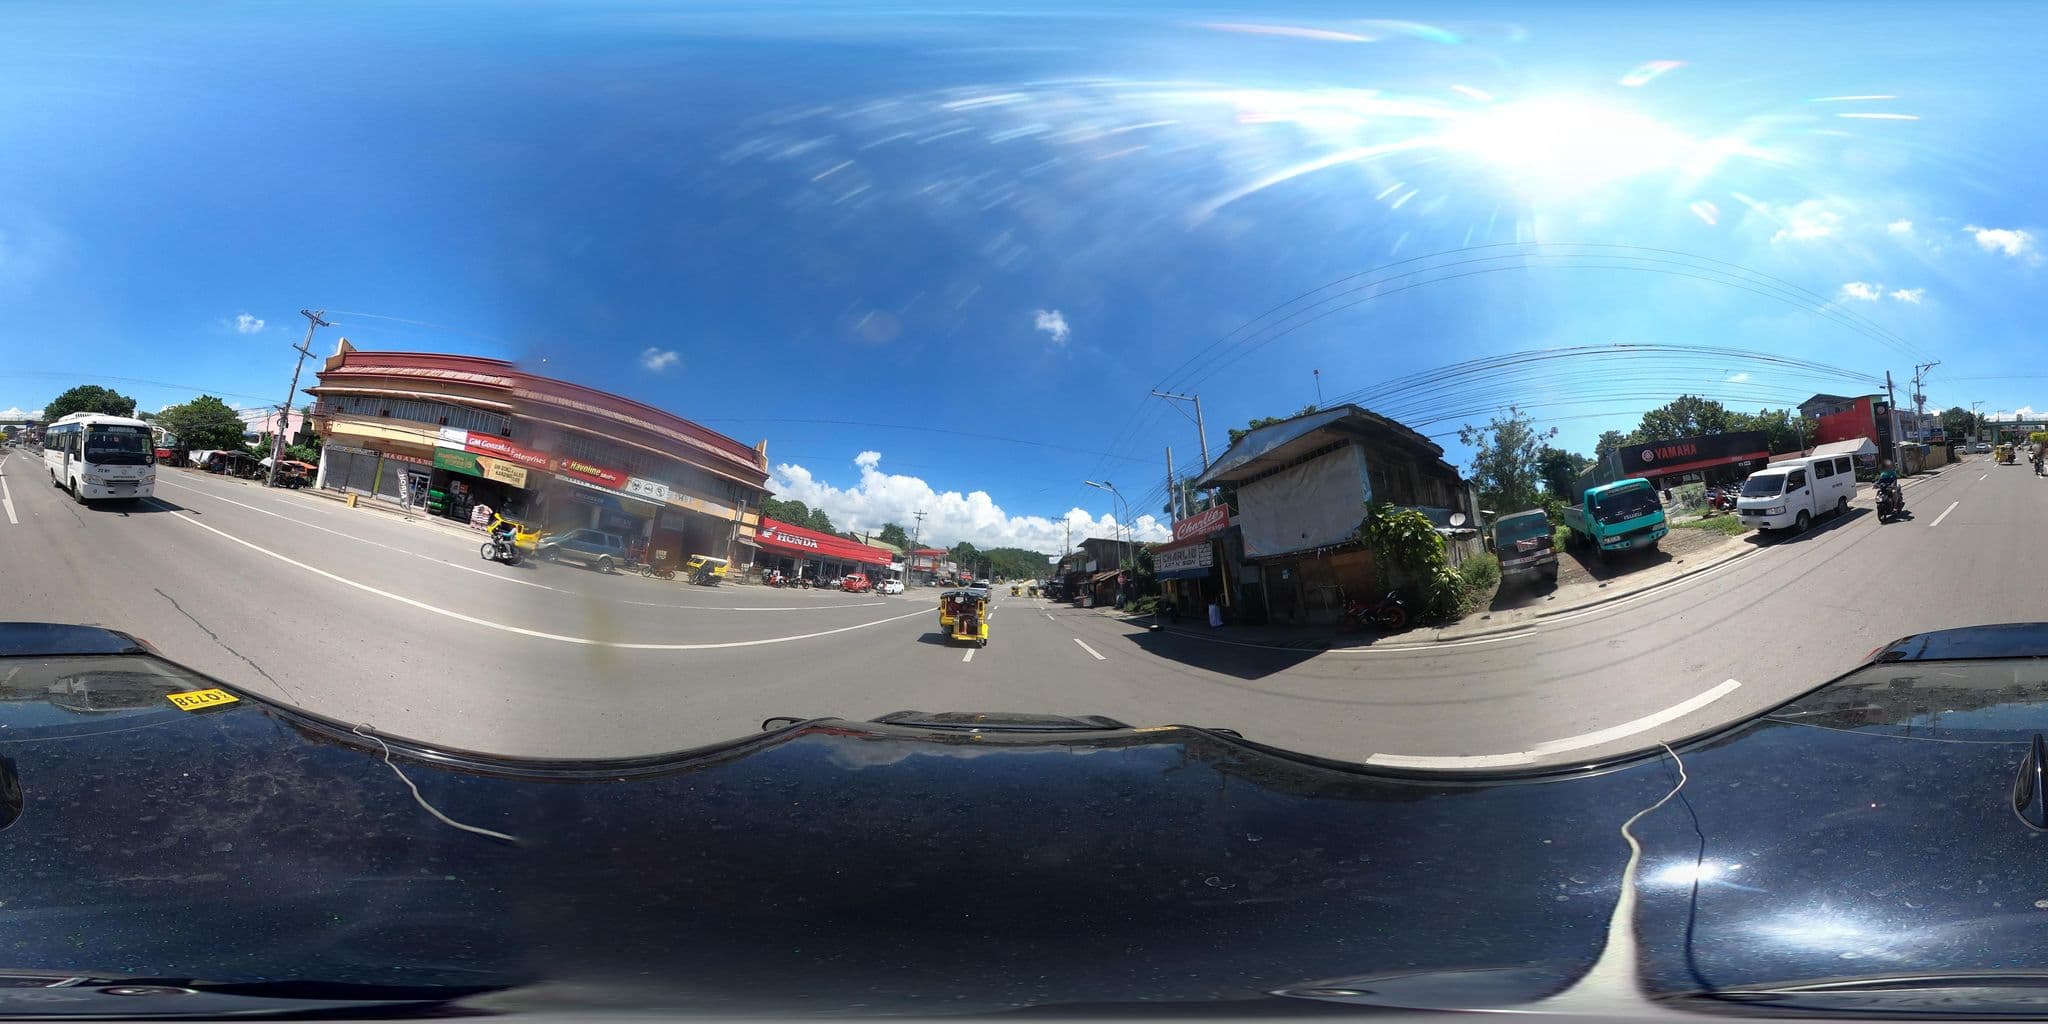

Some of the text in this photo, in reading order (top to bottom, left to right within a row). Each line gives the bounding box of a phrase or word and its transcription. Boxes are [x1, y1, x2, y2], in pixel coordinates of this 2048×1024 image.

[469, 437, 547, 465] GM Gonzales Enterprises
[1655, 444, 1697, 459] YAMAHA
[570, 460, 601, 476] Havoline
[1623, 511, 1643, 520] ISUZU
[1177, 510, 1223, 540] Charlie
[776, 532, 818, 549] HONDA
[1162, 546, 1198, 562] CHARLIE
